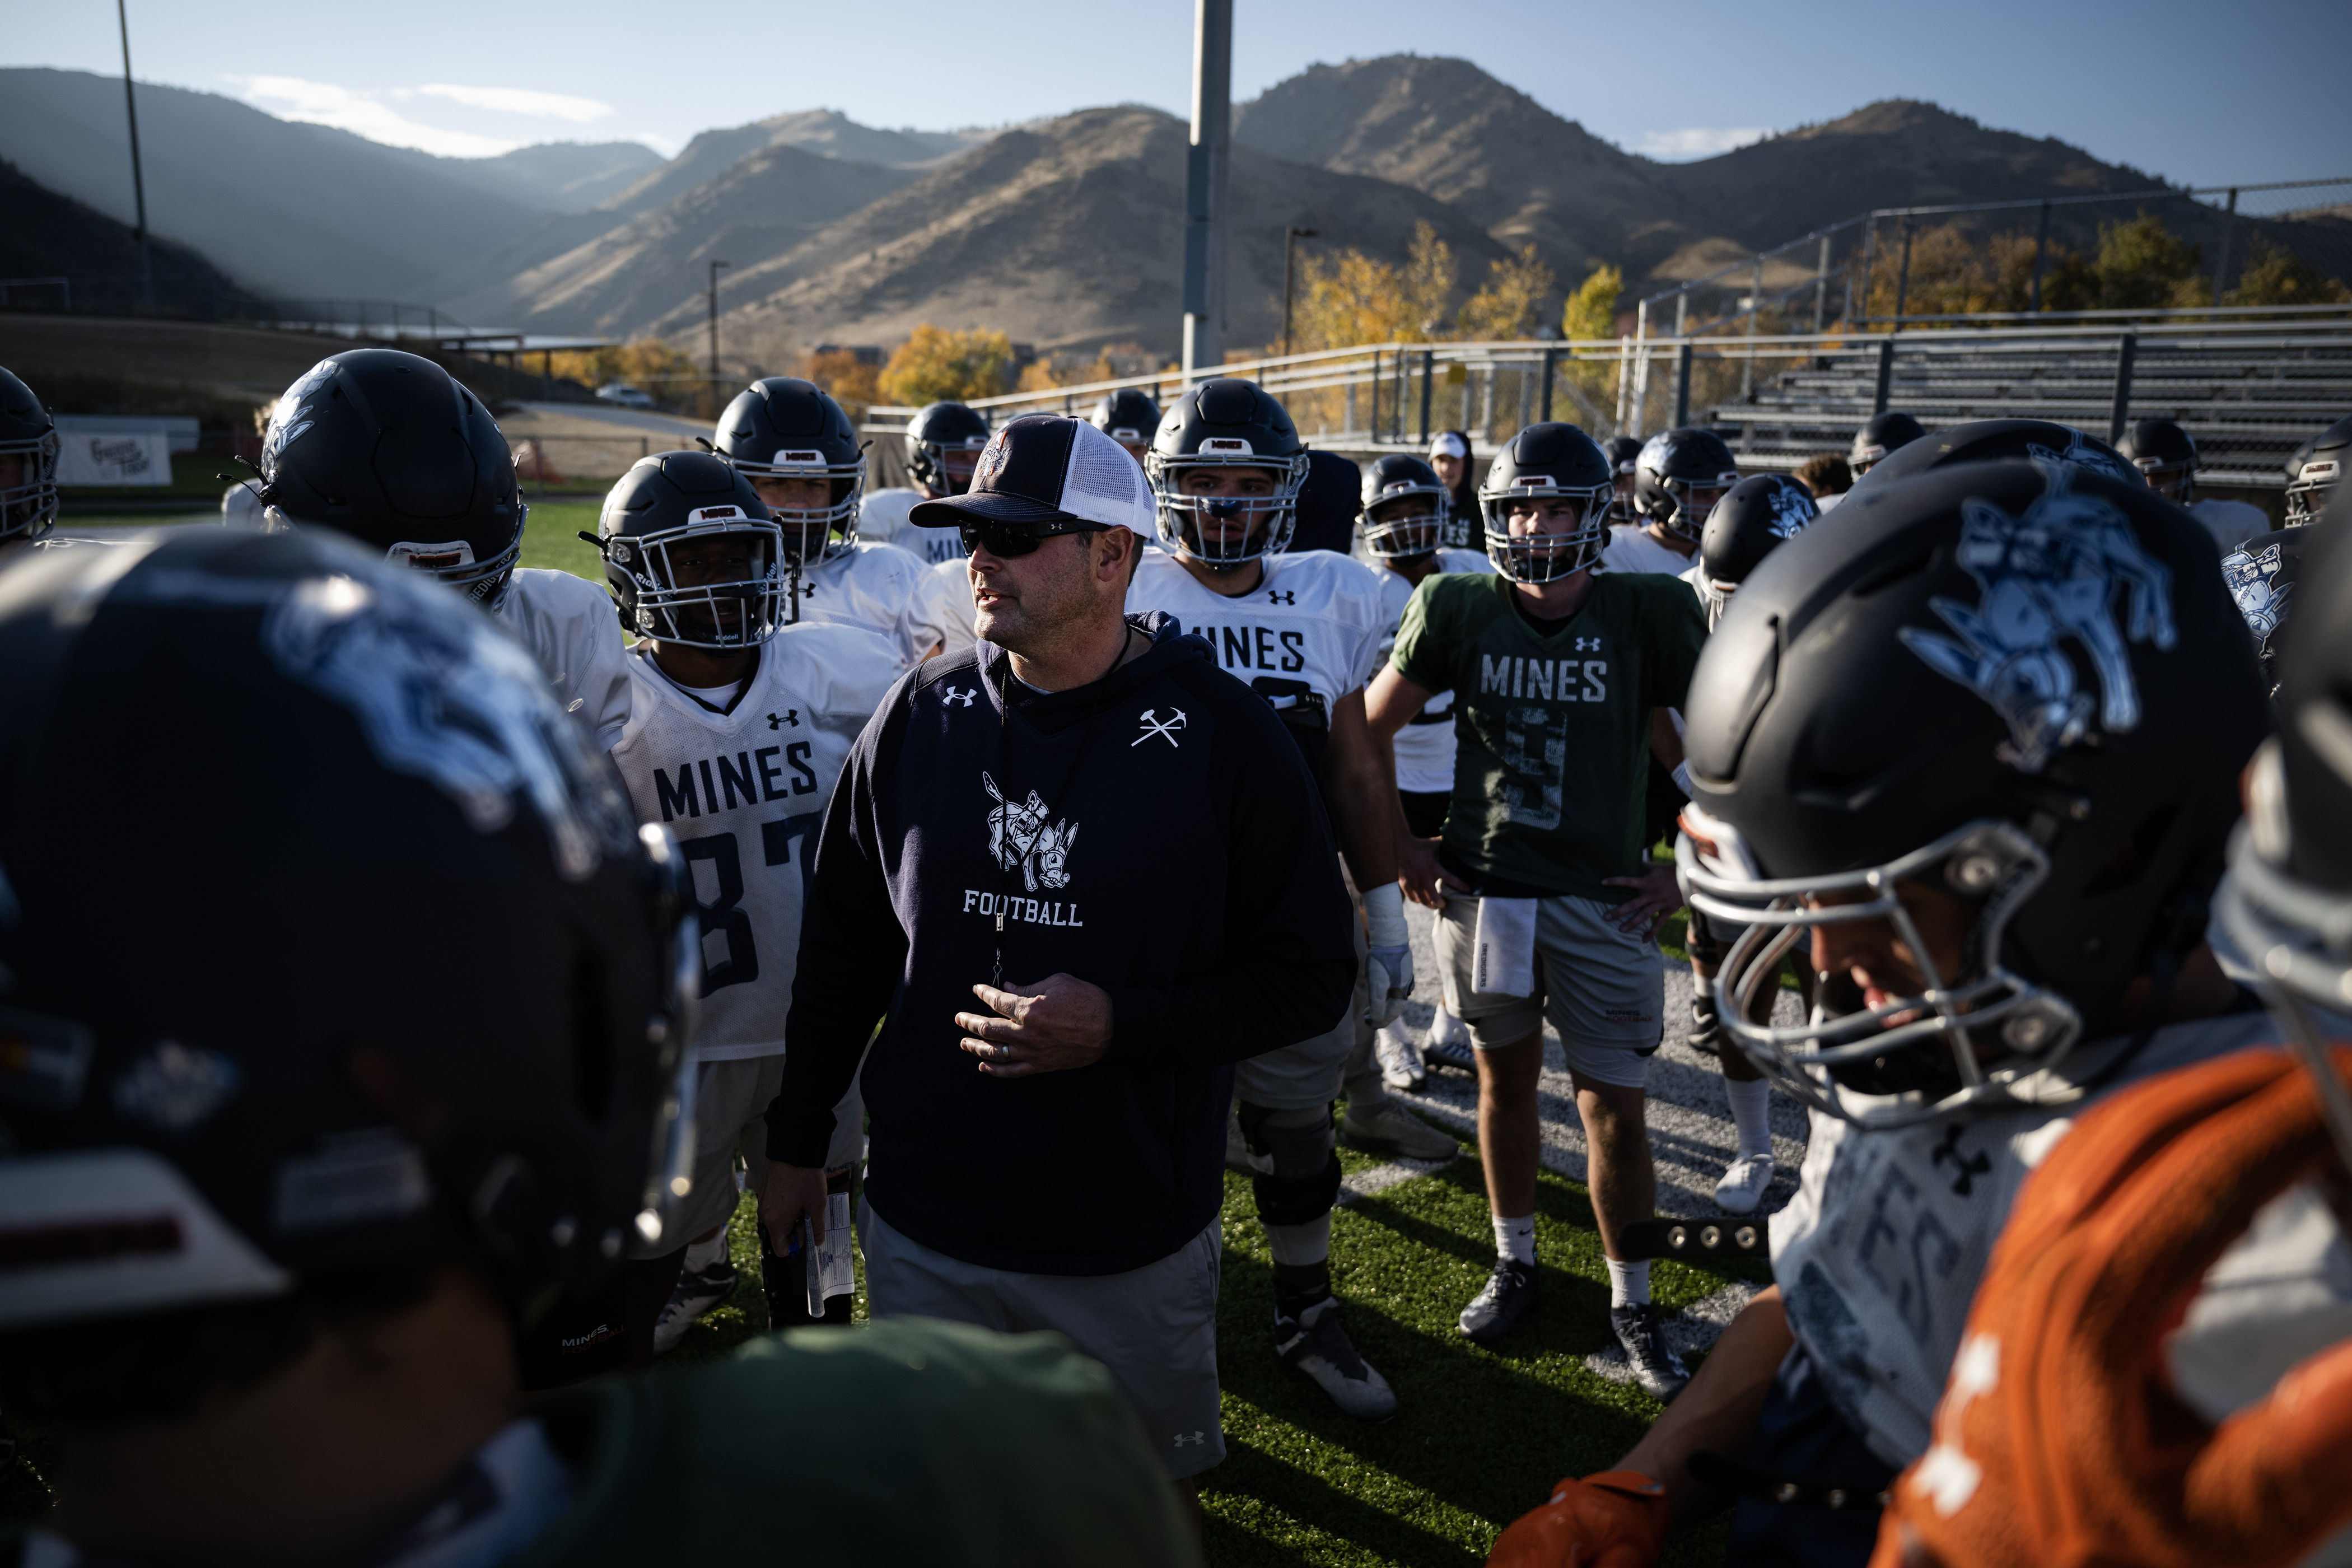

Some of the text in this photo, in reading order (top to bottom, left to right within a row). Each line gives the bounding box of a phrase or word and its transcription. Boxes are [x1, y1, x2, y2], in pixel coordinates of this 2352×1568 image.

[700, 507, 736, 520] MINES
[409, 552, 461, 567] MINES
[1192, 627, 1304, 672] INES
[1480, 654, 1607, 702] MINES
[654, 741, 818, 822] MINES
[679, 809, 824, 1000] 87
[963, 889, 1083, 927] FOOTBALL
[562, 1324, 627, 1355] FOOTBALL
